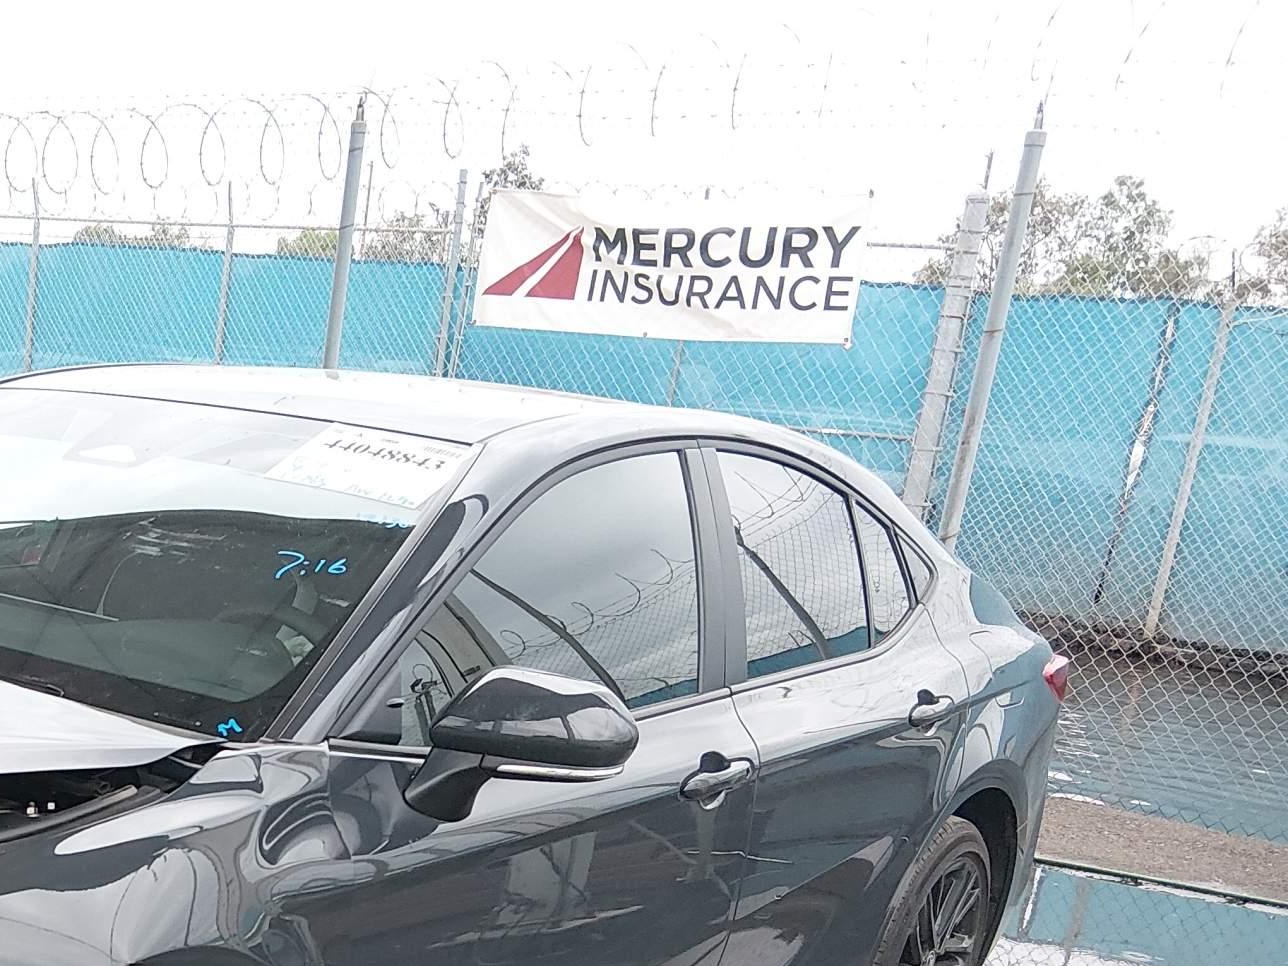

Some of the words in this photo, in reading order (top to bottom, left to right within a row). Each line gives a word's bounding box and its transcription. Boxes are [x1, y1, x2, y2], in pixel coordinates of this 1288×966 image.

[593, 226, 862, 269] MERCURY
[587, 268, 854, 312] INSURANCE
[275, 550, 347, 579] 7:16
